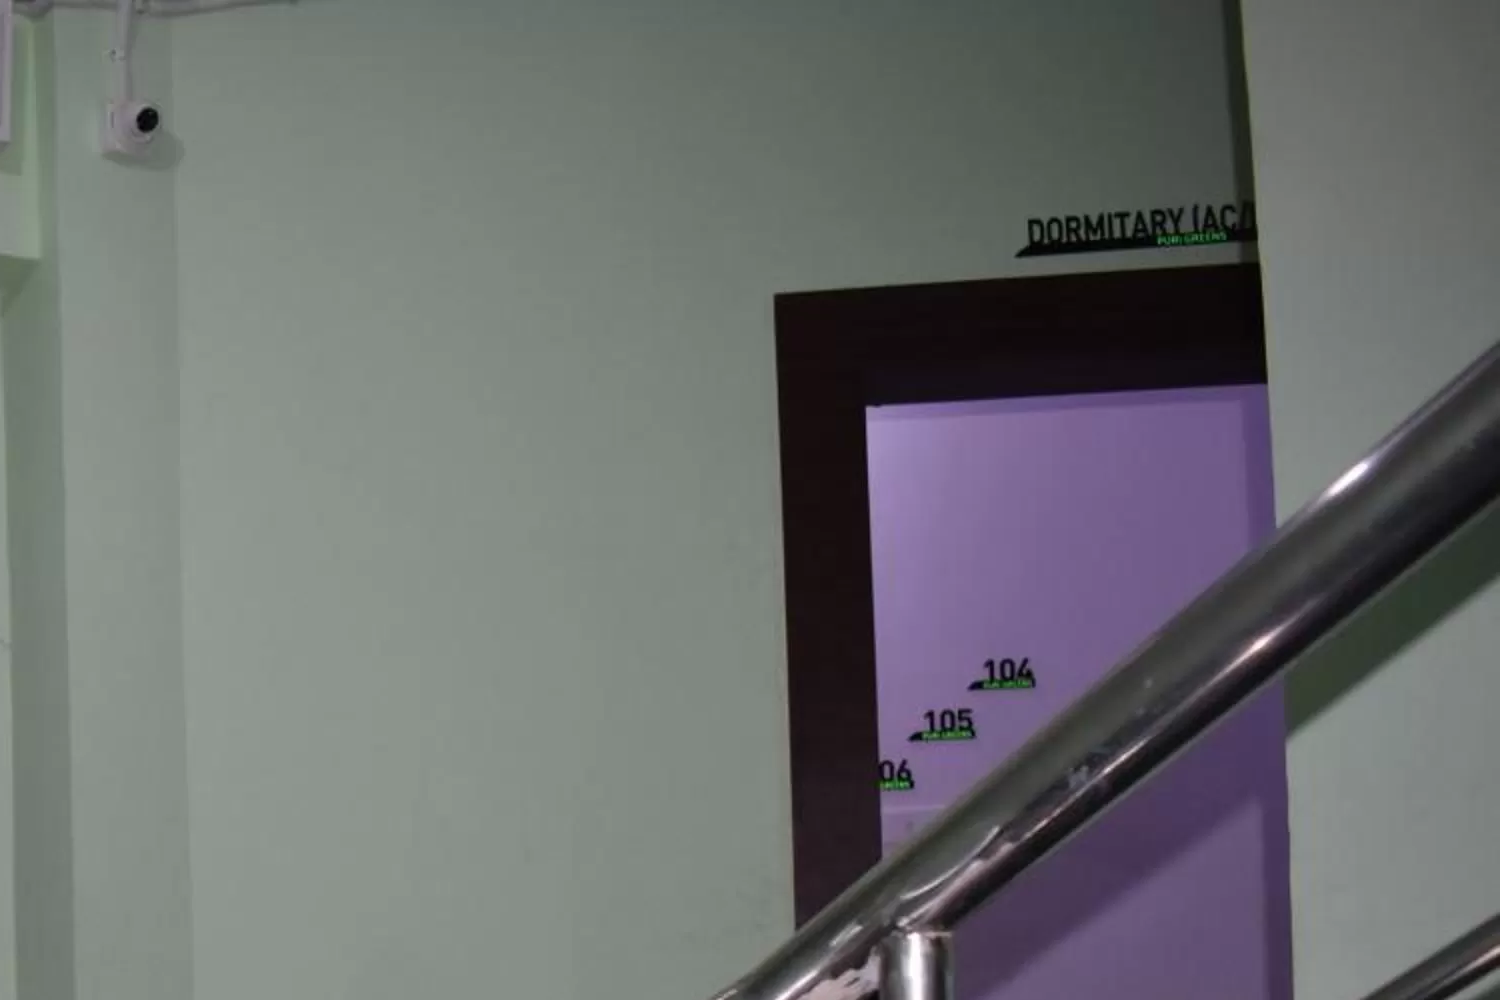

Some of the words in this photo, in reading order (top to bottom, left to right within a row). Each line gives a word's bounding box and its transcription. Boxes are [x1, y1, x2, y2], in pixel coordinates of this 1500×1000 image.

[1027, 208, 1183, 246] DORMITARY
[984, 658, 1032, 683] 104
[924, 709, 974, 734] 105
